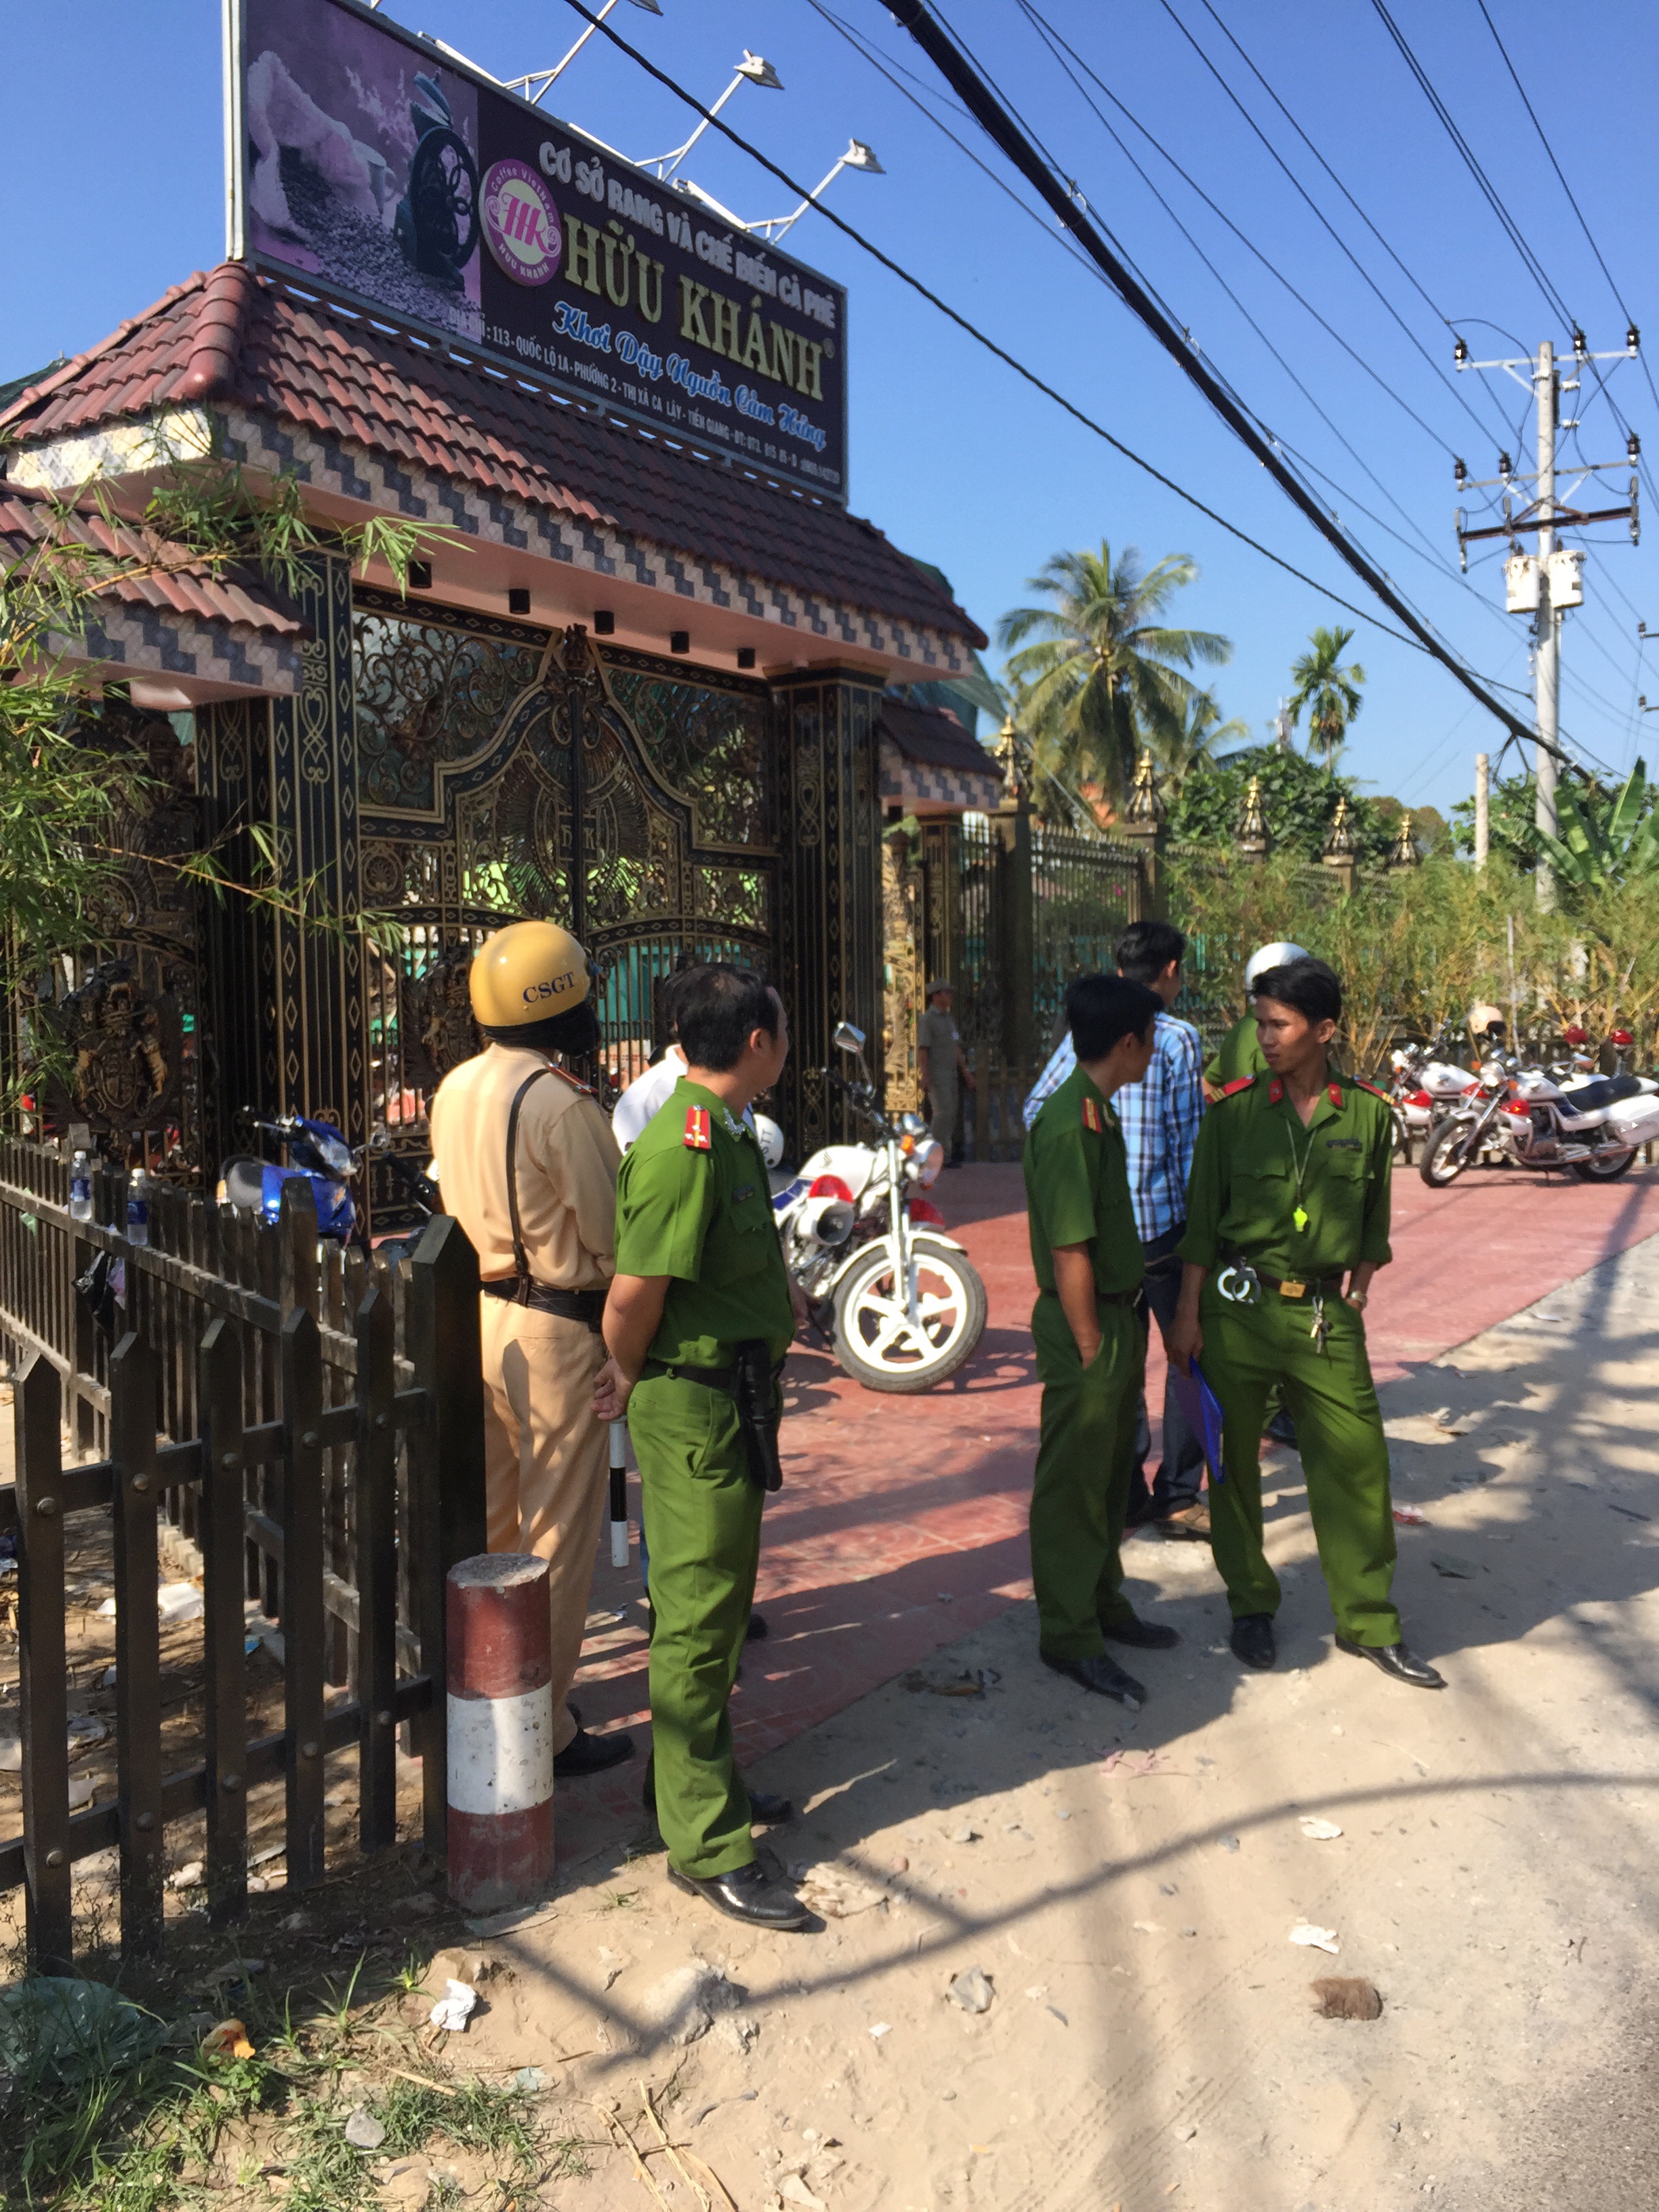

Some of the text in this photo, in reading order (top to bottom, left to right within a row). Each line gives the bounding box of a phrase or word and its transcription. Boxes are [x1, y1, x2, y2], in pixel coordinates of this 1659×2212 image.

[539, 141, 571, 184] CƠ
[575, 156, 605, 202] SỞ
[607, 178, 664, 236] RANG
[666, 211, 693, 253] VÀ
[563, 212, 823, 401] HỮU KHÁNH
[493, 325, 510, 347] 113
[516, 335, 542, 361] QUỐC
[544, 345, 556, 371] LỘ
[558, 354, 569, 373] 1A
[611, 377, 617, 393] 2
[615, 330, 663, 382] Dậy
[523, 970, 575, 1003] CSGT
